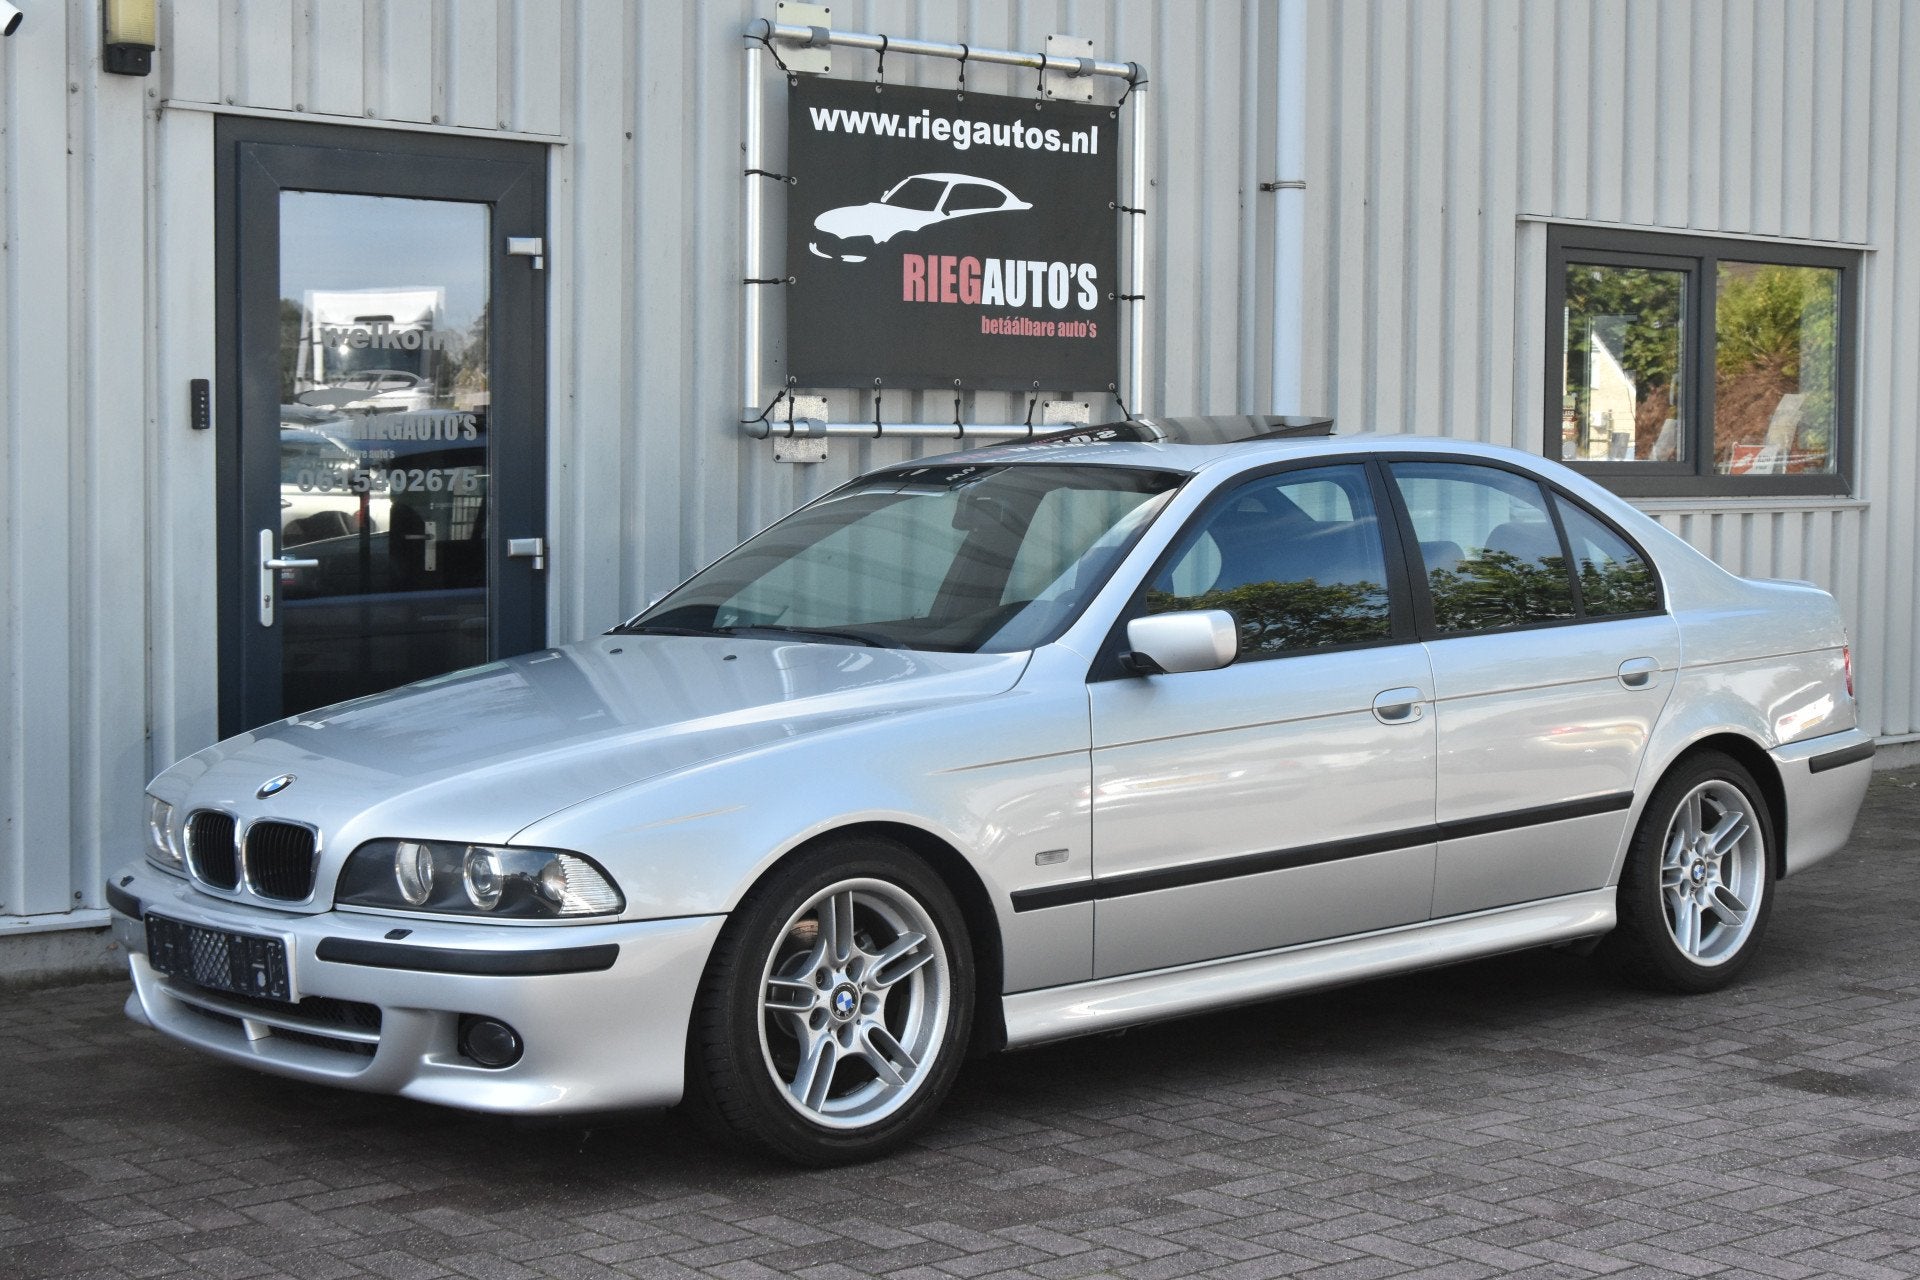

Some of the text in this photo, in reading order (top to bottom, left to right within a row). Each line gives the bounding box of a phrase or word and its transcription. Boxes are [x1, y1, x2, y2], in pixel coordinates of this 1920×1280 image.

[809, 107, 1098, 155] www.riegautos.nl
[902, 253, 1098, 311] RIEGAUTO'S
[319, 320, 450, 351] welkom
[981, 315, 1097, 339] betáálbare auto's
[297, 468, 478, 493] 0615402675
